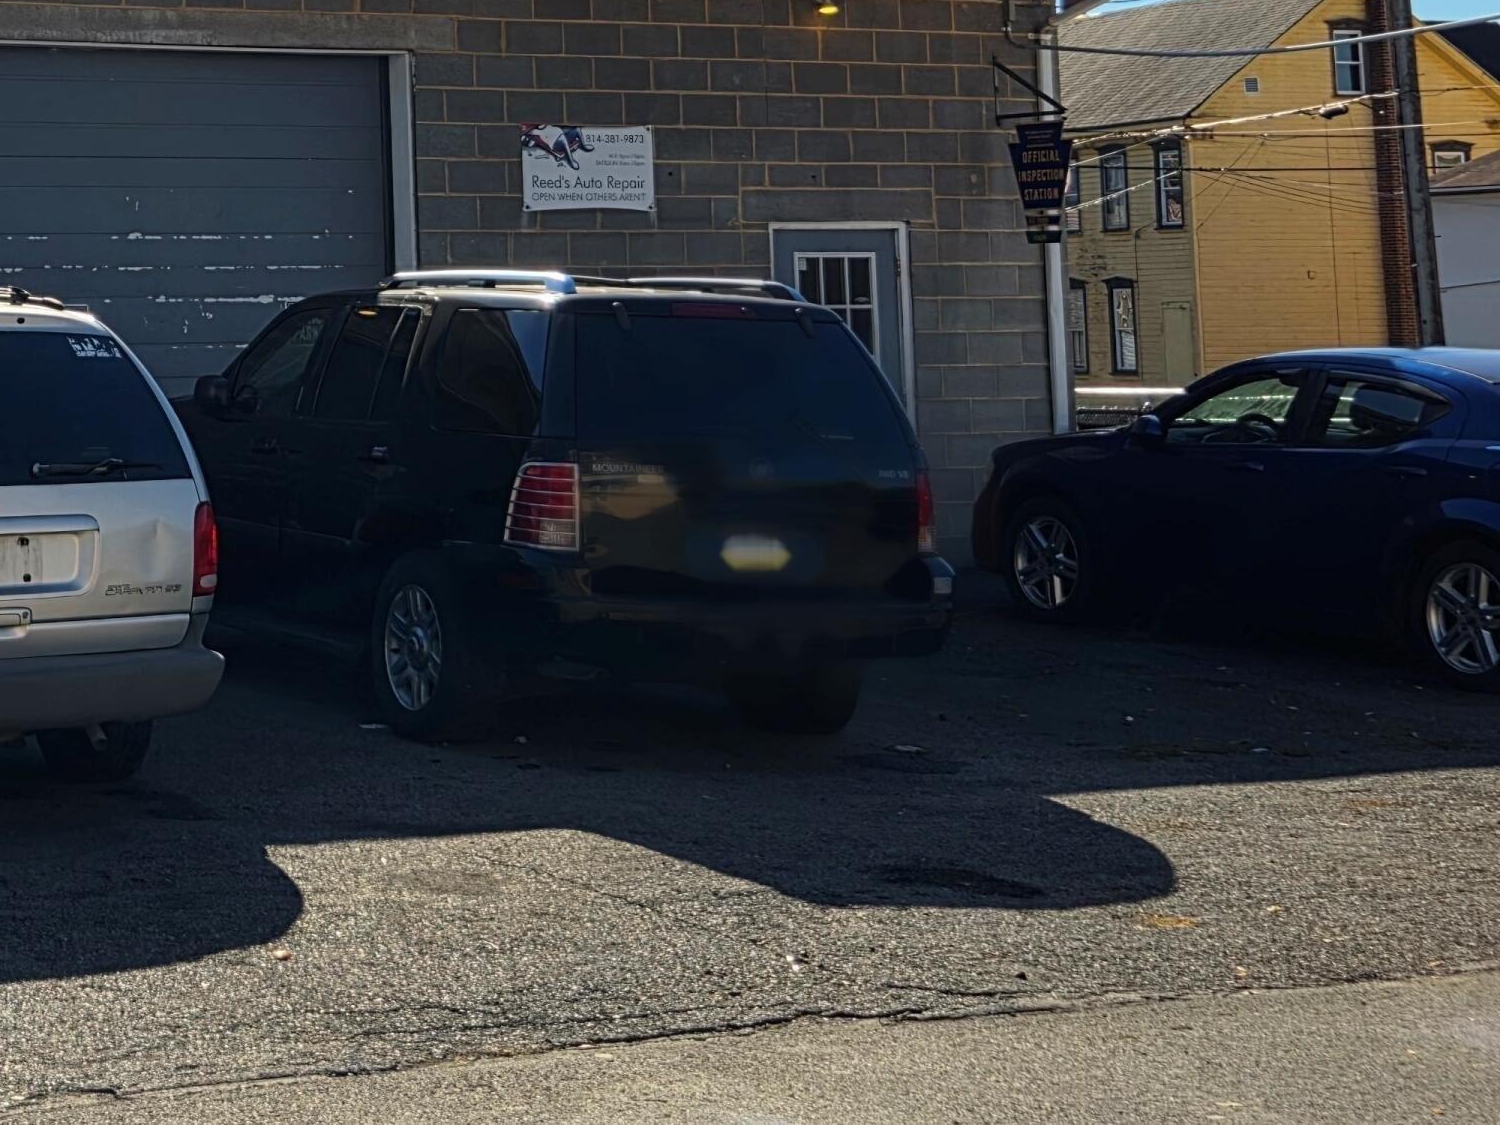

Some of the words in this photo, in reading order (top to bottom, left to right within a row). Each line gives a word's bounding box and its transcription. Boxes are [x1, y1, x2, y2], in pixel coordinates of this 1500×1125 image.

[585, 134, 644, 144] 814-381-9873
[1022, 150, 1060, 164] OFFICIAL
[1018, 169, 1065, 182] INSPECTION
[532, 174, 570, 188] Reed's
[574, 175, 602, 189] Auto
[607, 175, 645, 192] Repair
[532, 192, 555, 201] OPEN
[557, 192, 583, 201] WHEN
[586, 192, 617, 201] OTHERS
[1023, 187, 1059, 201] STATION
